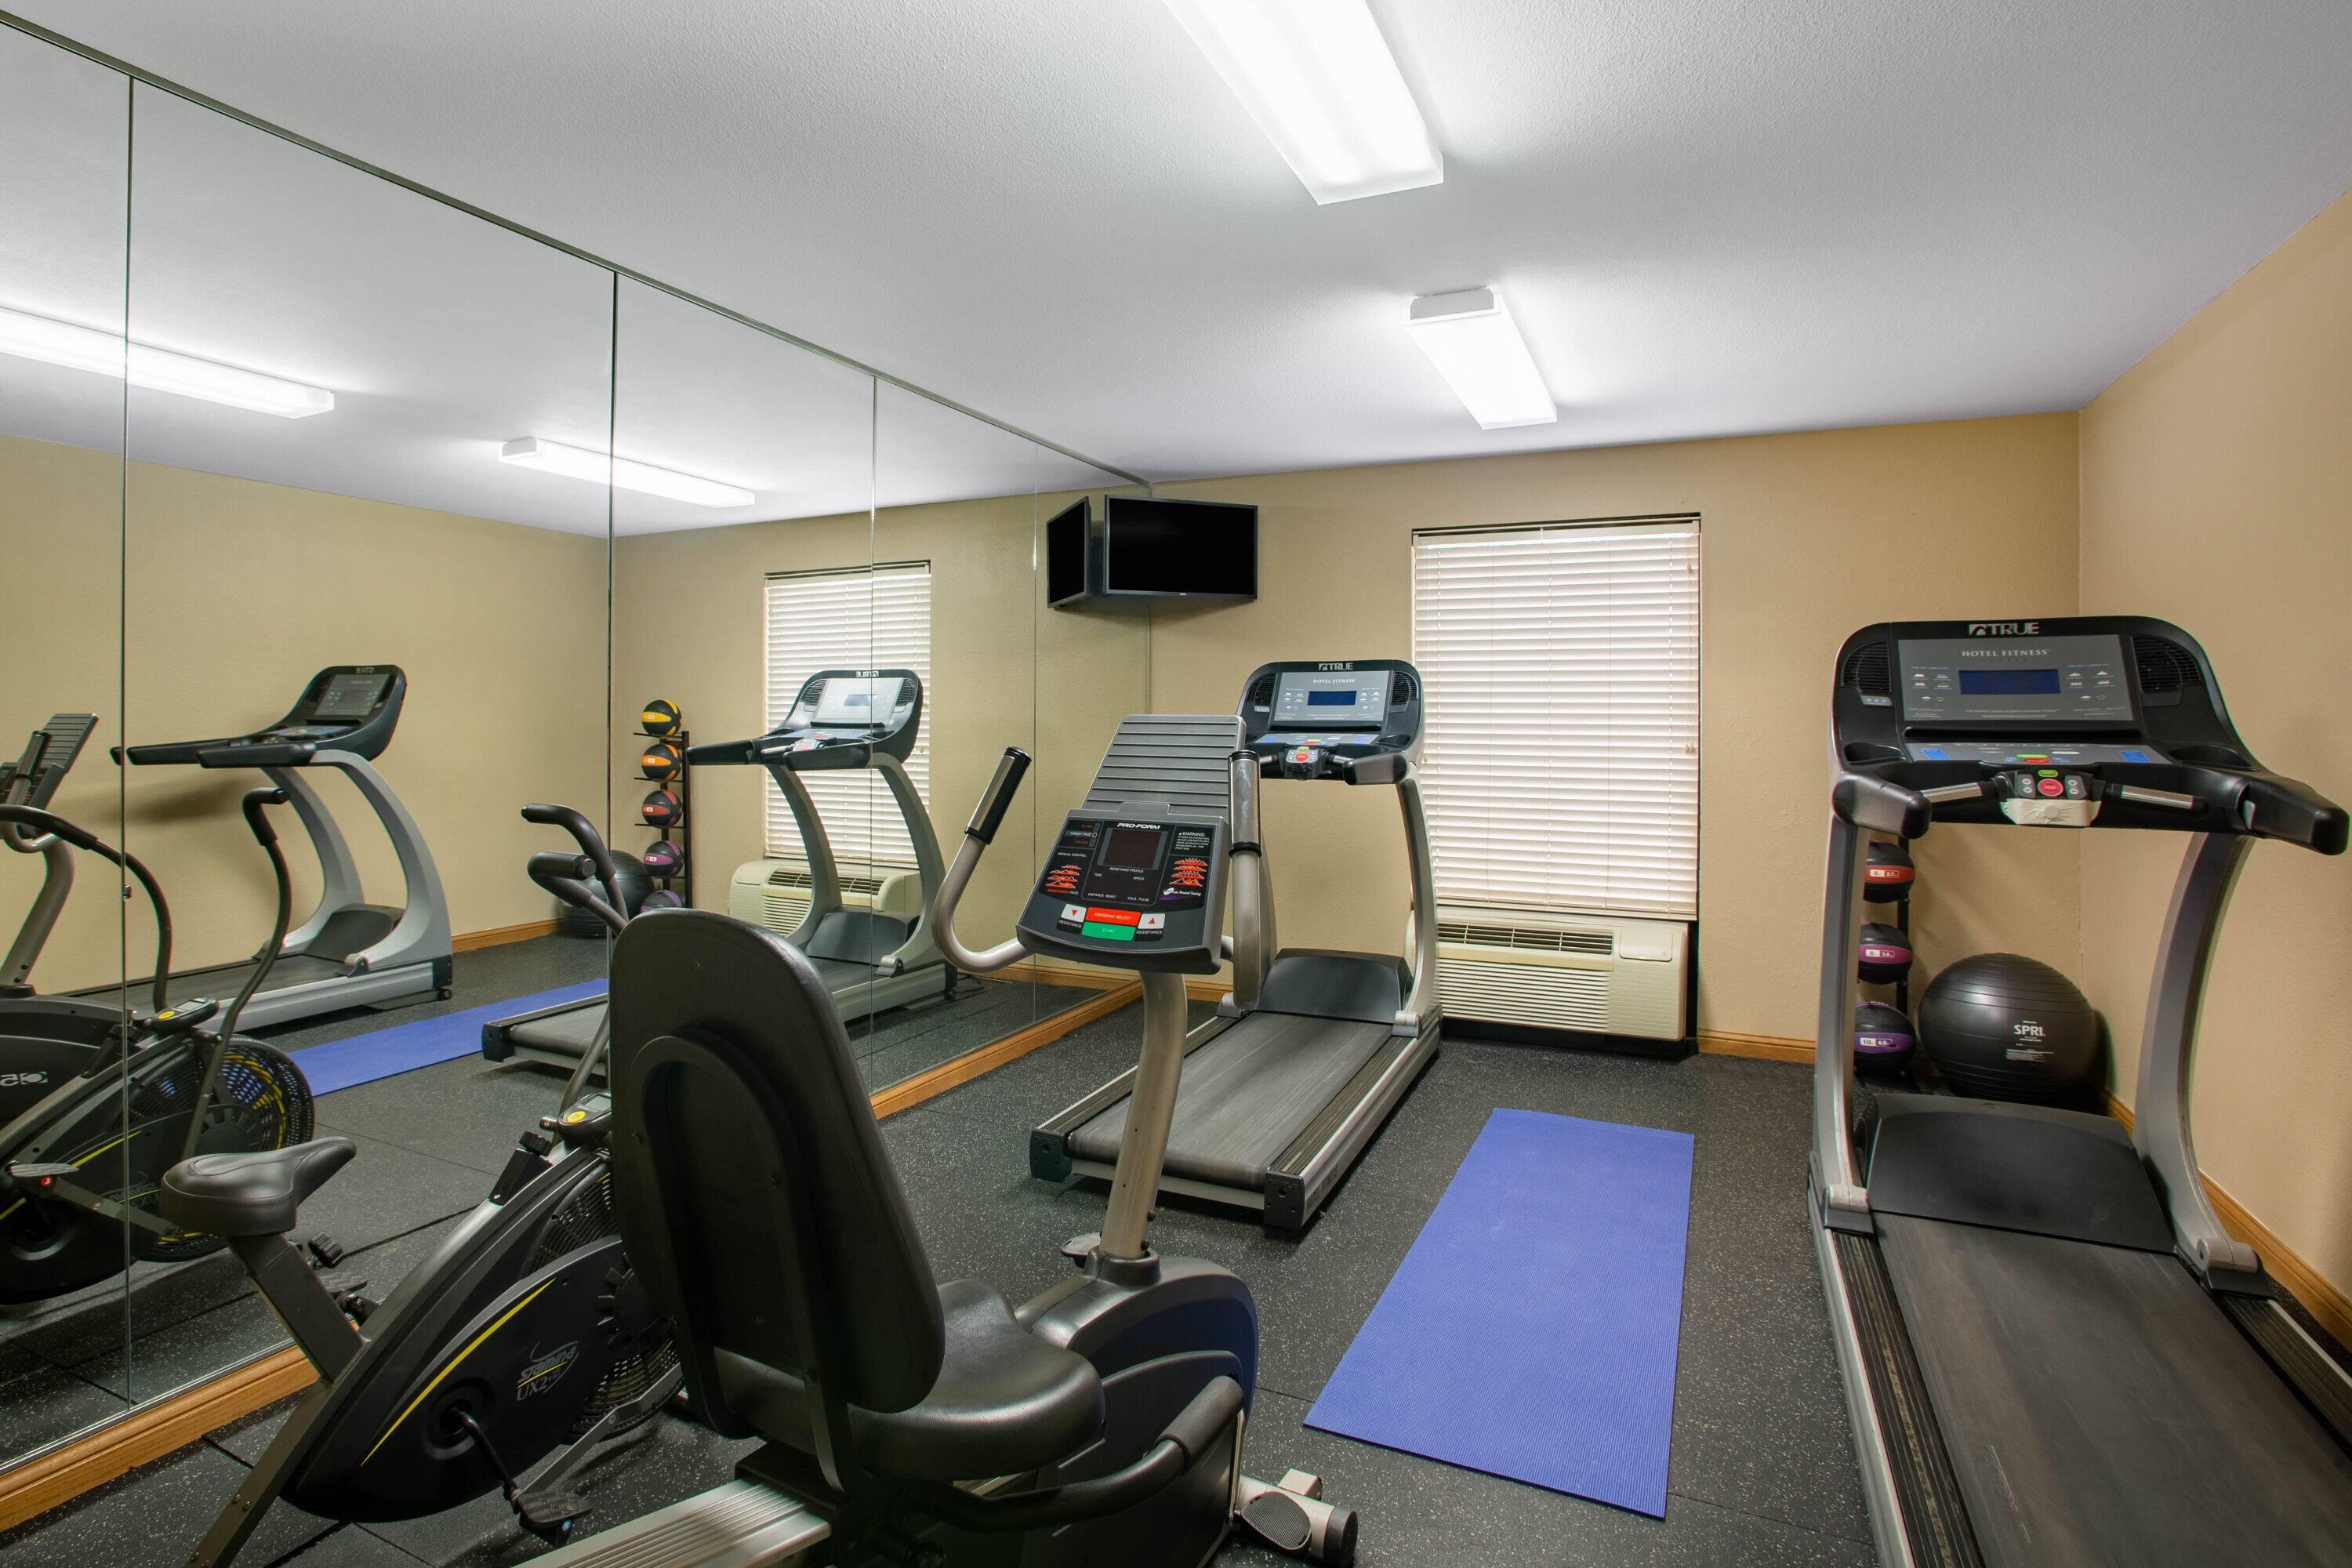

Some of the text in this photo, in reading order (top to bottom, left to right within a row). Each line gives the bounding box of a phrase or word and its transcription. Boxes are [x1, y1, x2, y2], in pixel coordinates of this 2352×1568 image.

[1987, 622, 2039, 635] TRUE
[1328, 662, 1354, 671] TRUE
[1058, 920, 1081, 928] RESISTANCE
[2013, 1024, 2045, 1036] SPRI
